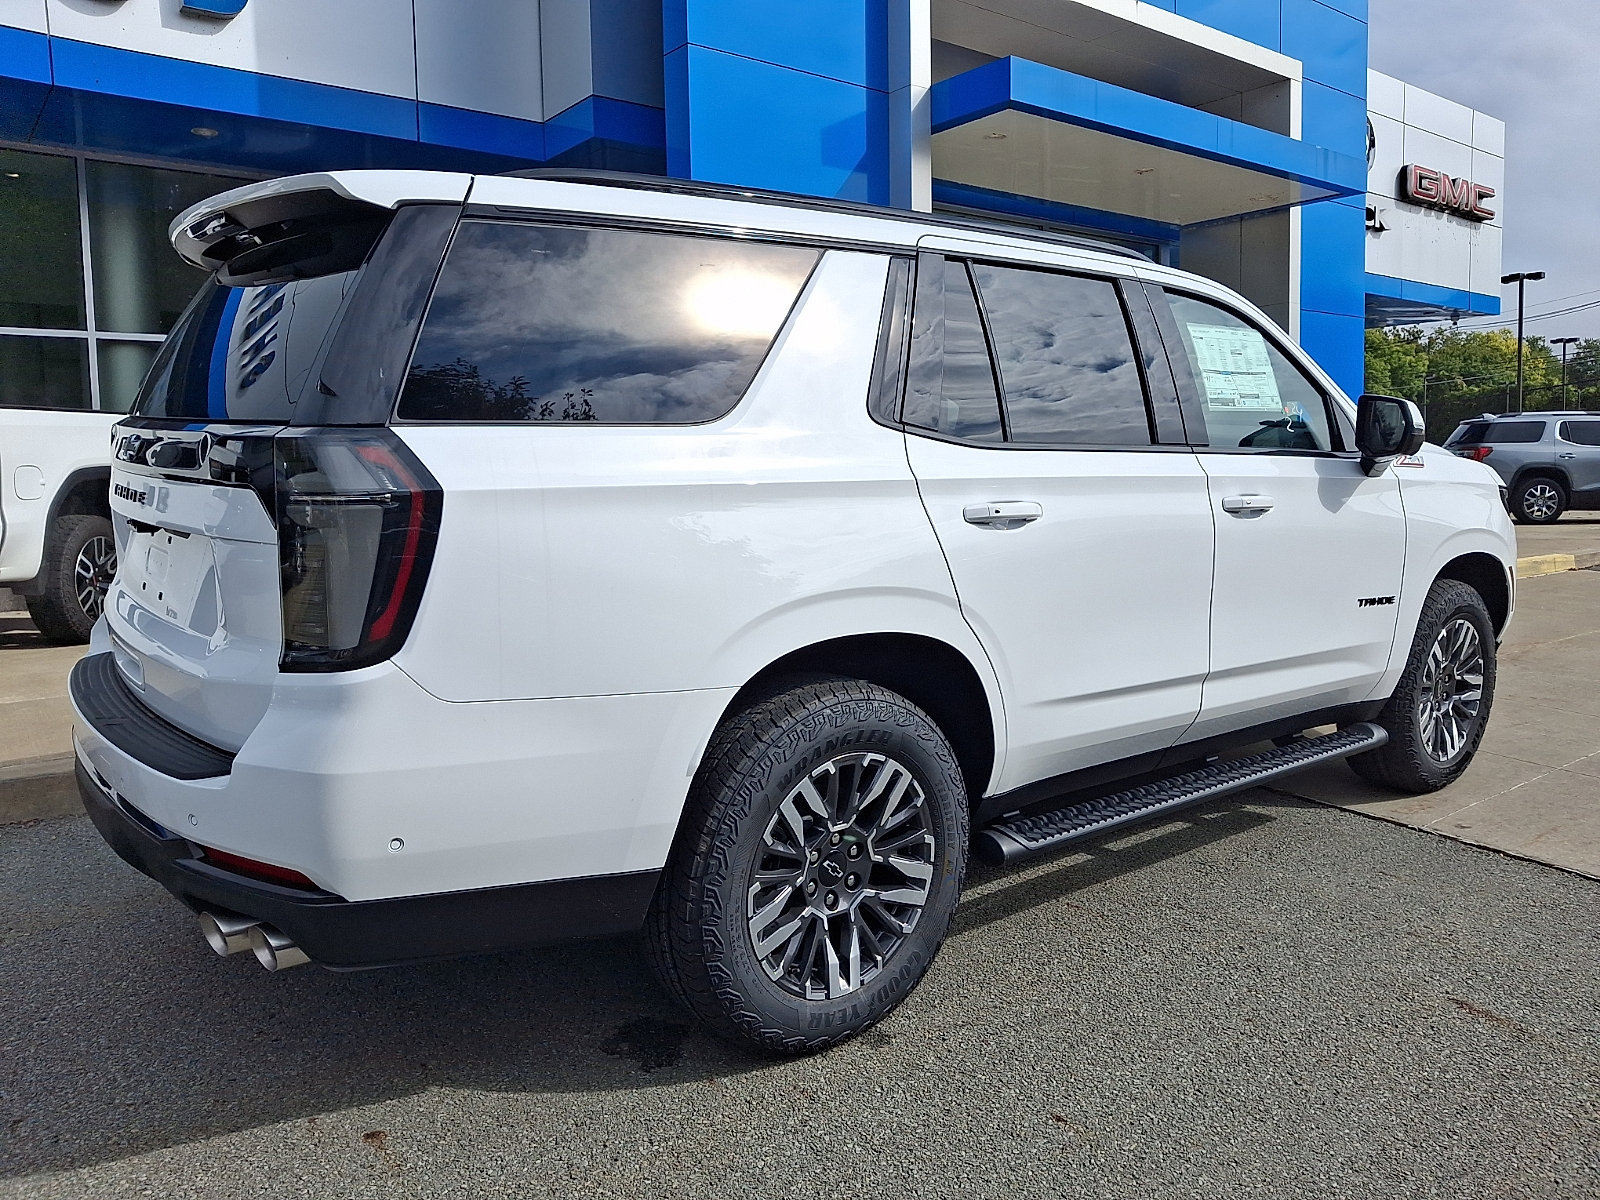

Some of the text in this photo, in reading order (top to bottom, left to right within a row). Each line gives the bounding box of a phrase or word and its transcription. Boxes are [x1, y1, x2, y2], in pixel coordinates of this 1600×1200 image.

[1402, 163, 1496, 220] GMC
[114, 483, 147, 505] TAHOE
[1357, 595, 1396, 608] TAHOE
[777, 729, 893, 793] WRANGLER
